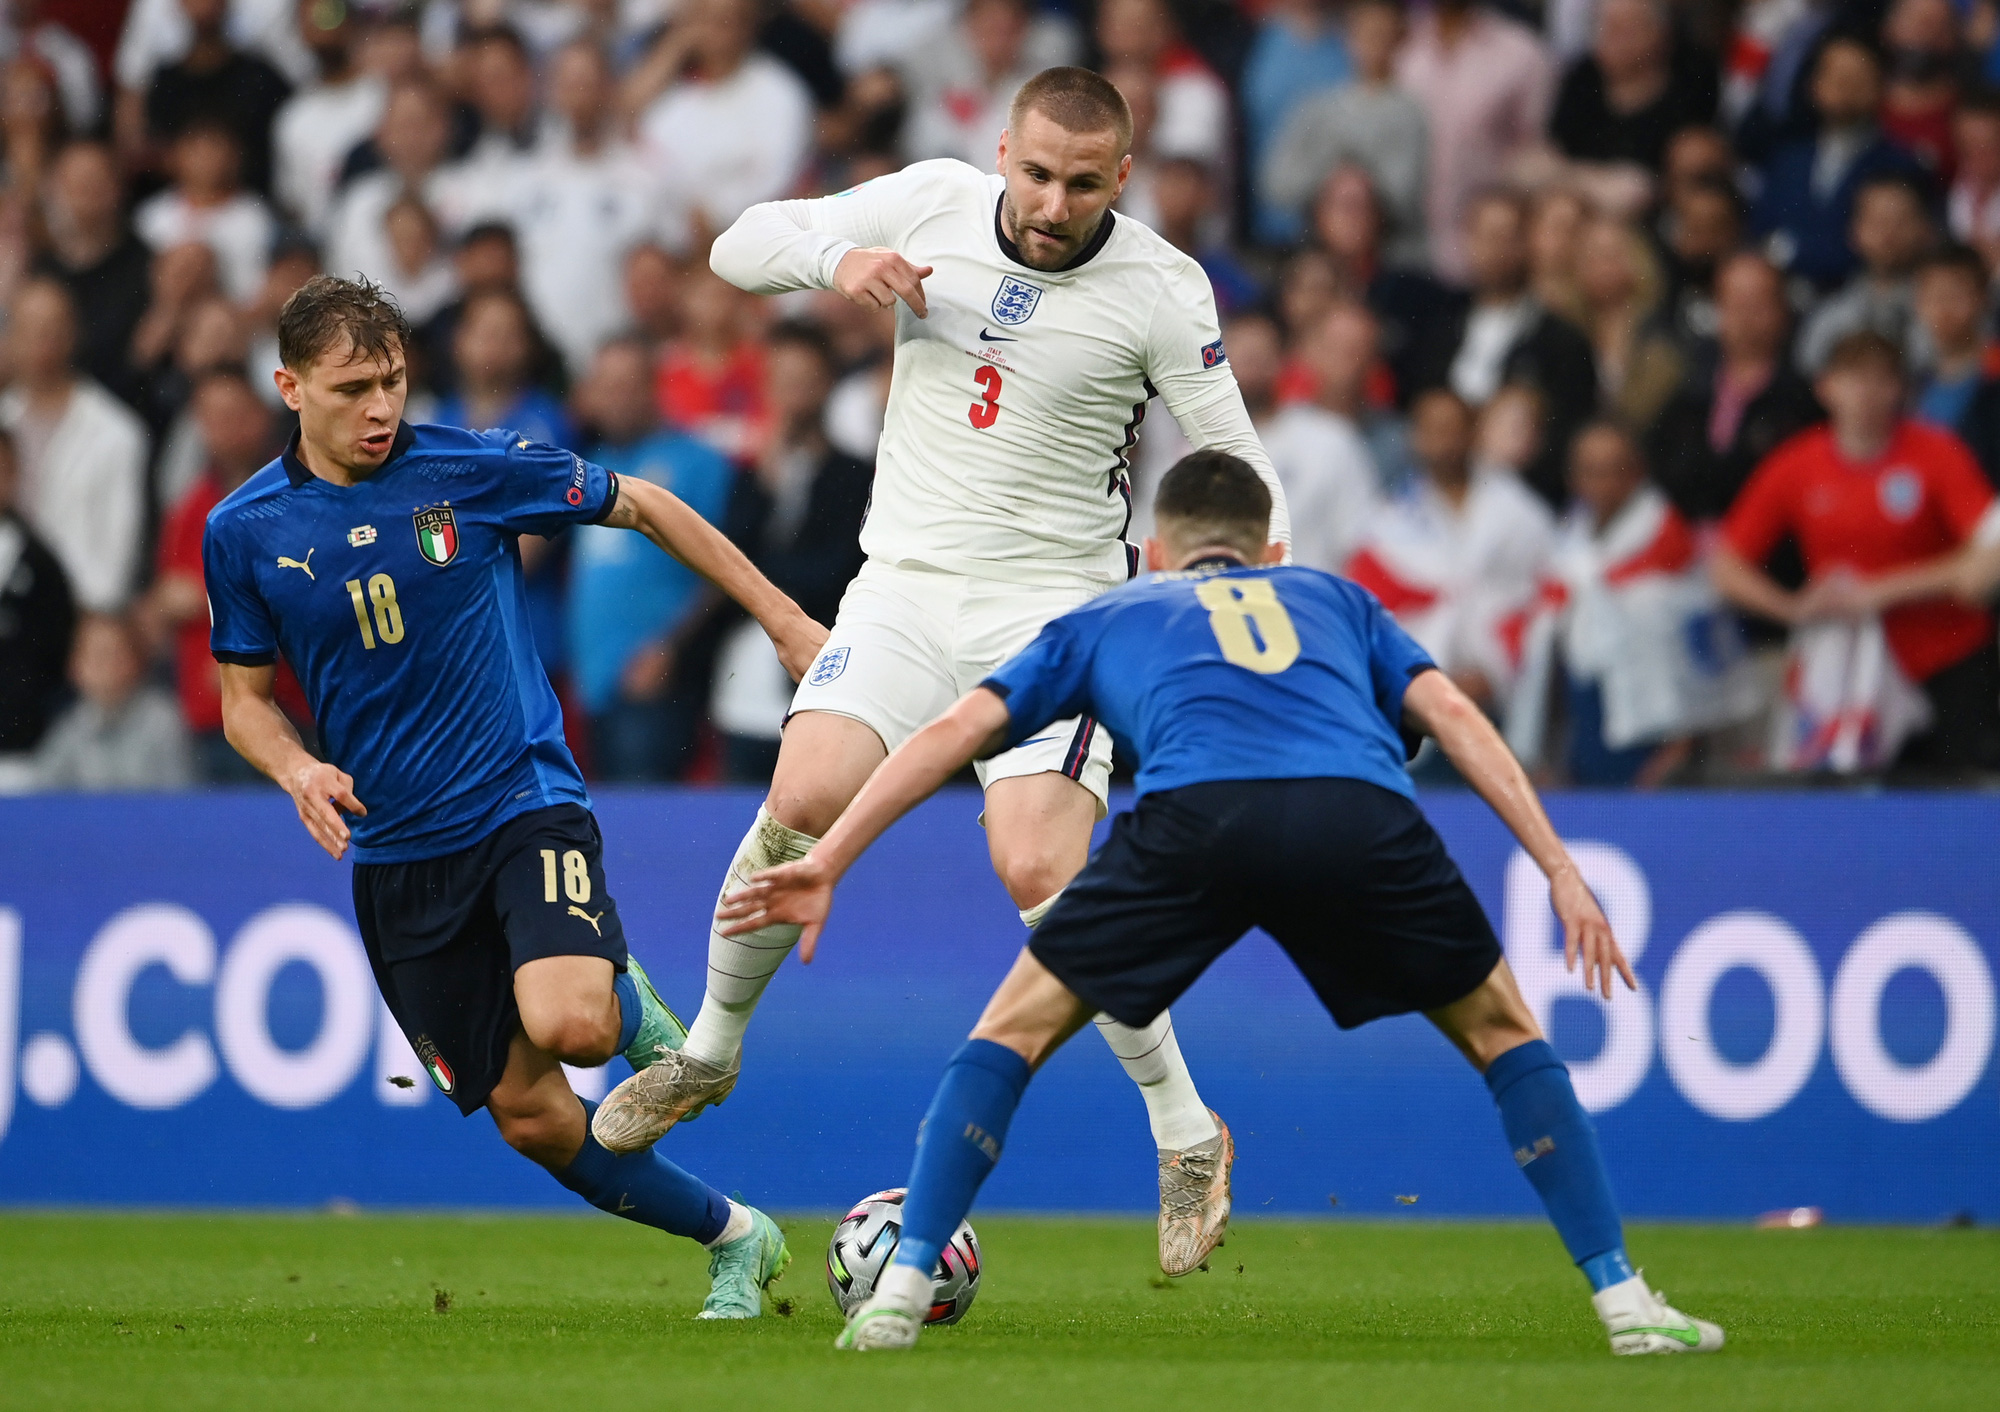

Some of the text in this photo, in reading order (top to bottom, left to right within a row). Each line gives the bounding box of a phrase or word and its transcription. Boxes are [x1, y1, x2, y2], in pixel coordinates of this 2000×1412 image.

[987, 346, 1002, 355] ITALY
[968, 365, 1002, 429] 3
[571, 452, 585, 488] RESPEC
[417, 512, 450, 526] ITALIA
[345, 573, 405, 650] 18
[1194, 577, 1301, 674] 8
[540, 849, 592, 904] 18
[1504, 840, 1995, 1121] Boo
[0, 900, 608, 1145] .co
